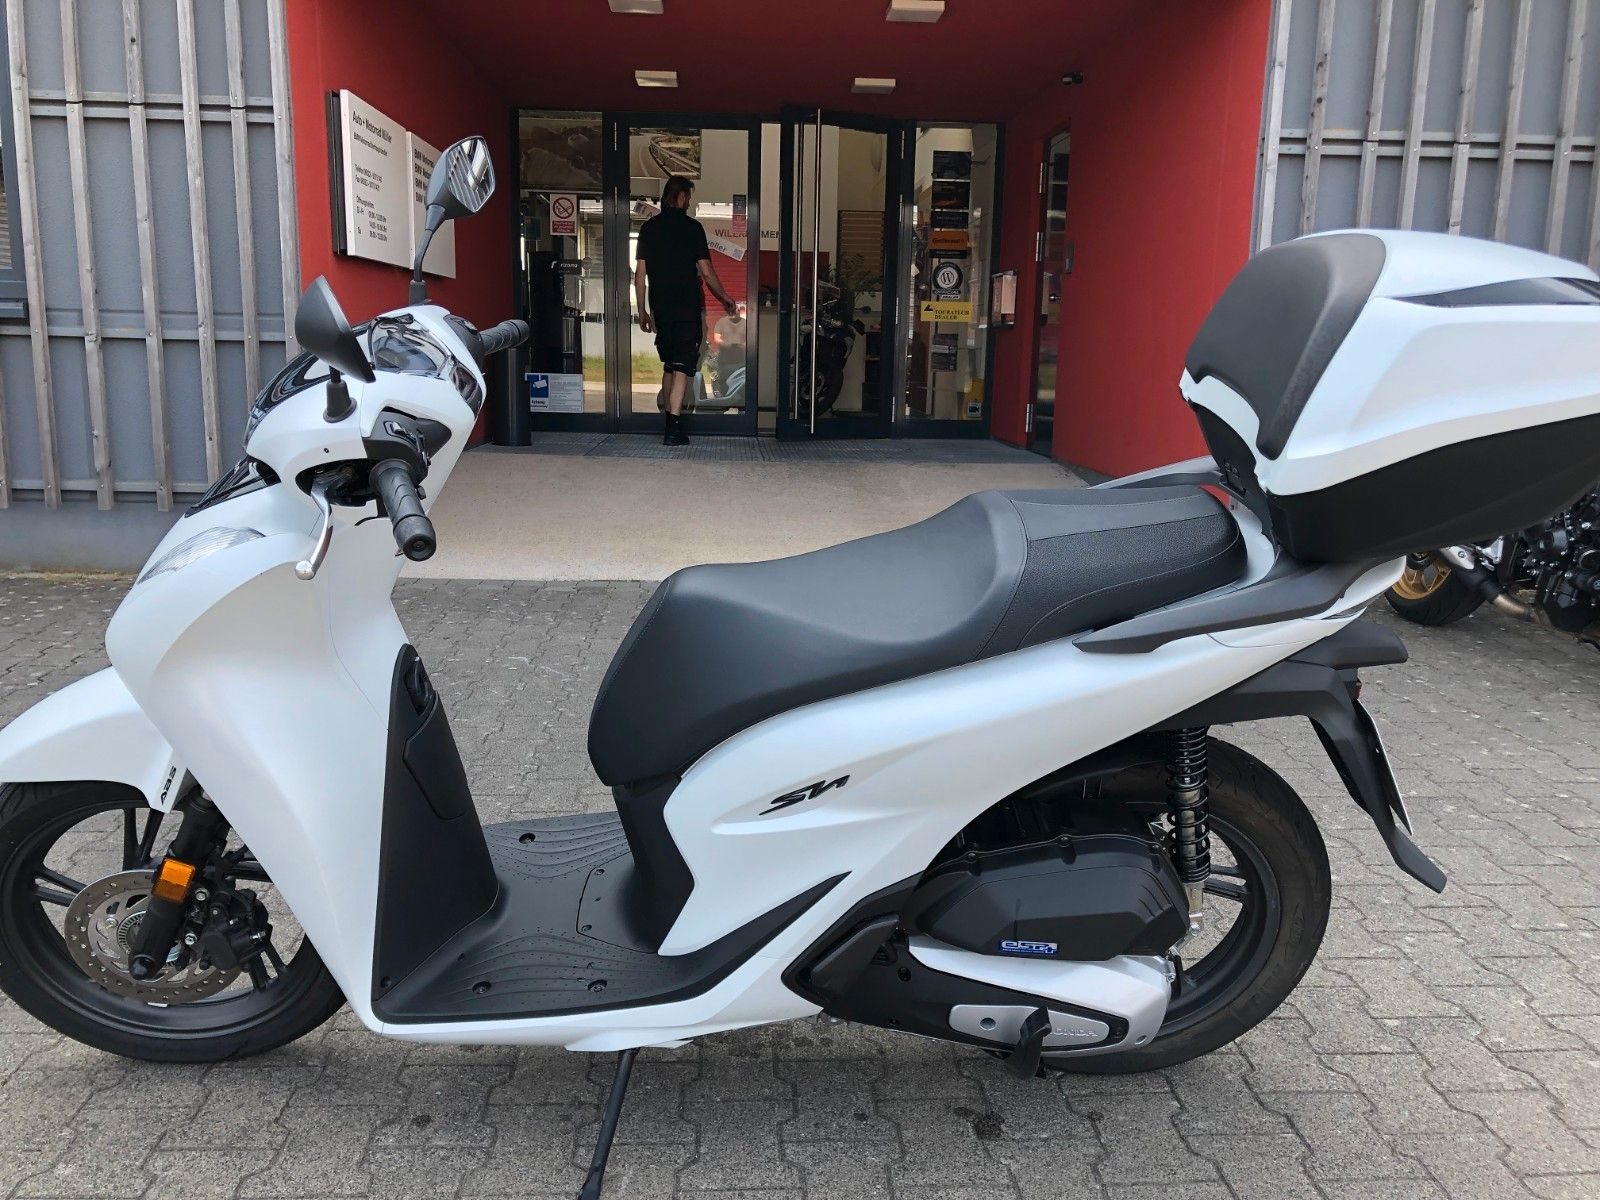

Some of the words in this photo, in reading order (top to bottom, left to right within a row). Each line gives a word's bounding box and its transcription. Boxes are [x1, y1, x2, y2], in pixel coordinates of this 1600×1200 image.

[353, 110, 363, 126] Auto
[160, 765, 177, 806] ABS
[1051, 1027, 1098, 1037] ONDA
